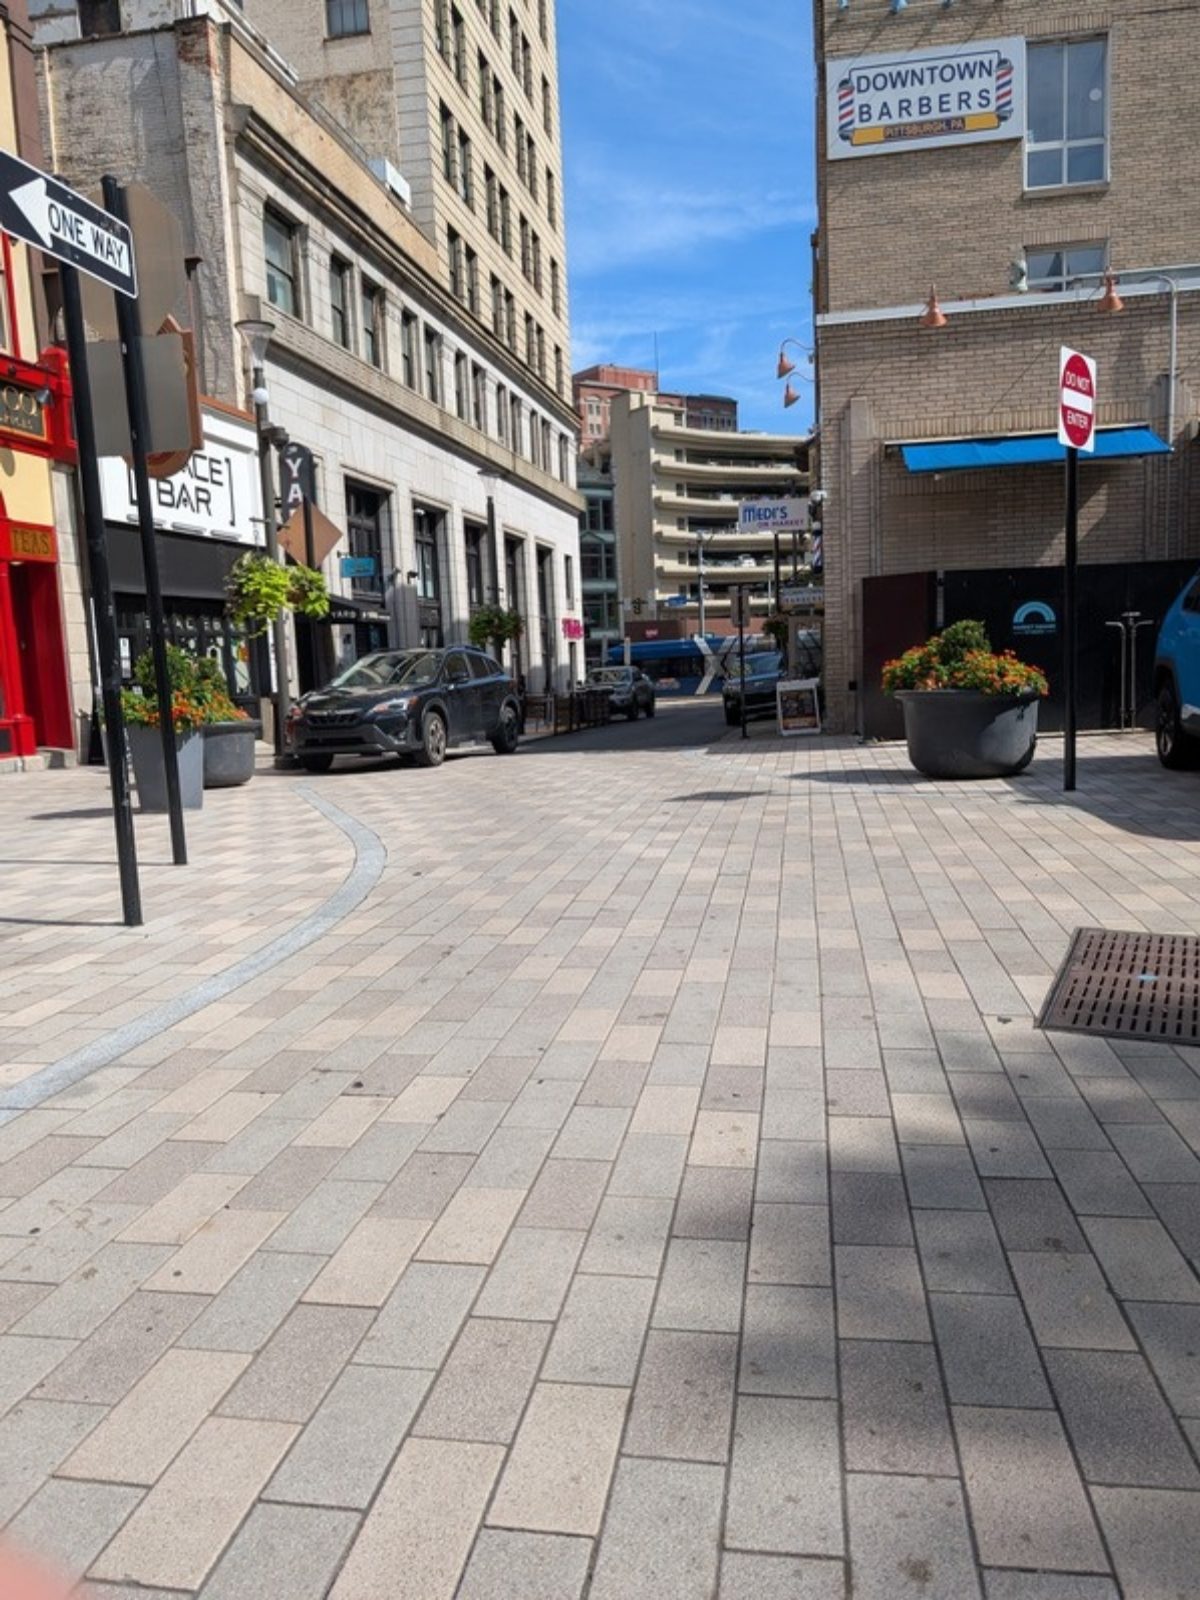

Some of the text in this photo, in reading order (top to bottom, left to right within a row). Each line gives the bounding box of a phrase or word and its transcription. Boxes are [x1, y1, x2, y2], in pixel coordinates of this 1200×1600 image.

[856, 60, 993, 95] DOWNTOWN
[858, 90, 991, 124] BARBERS
[950, 119, 964, 131] PA
[48, 203, 123, 268] ONE WAY
[1065, 371, 1090, 392] DO NOT
[1067, 409, 1088, 430] ENTER
[156, 479, 212, 517] BAR
[13, 528, 49, 556] TEAS
